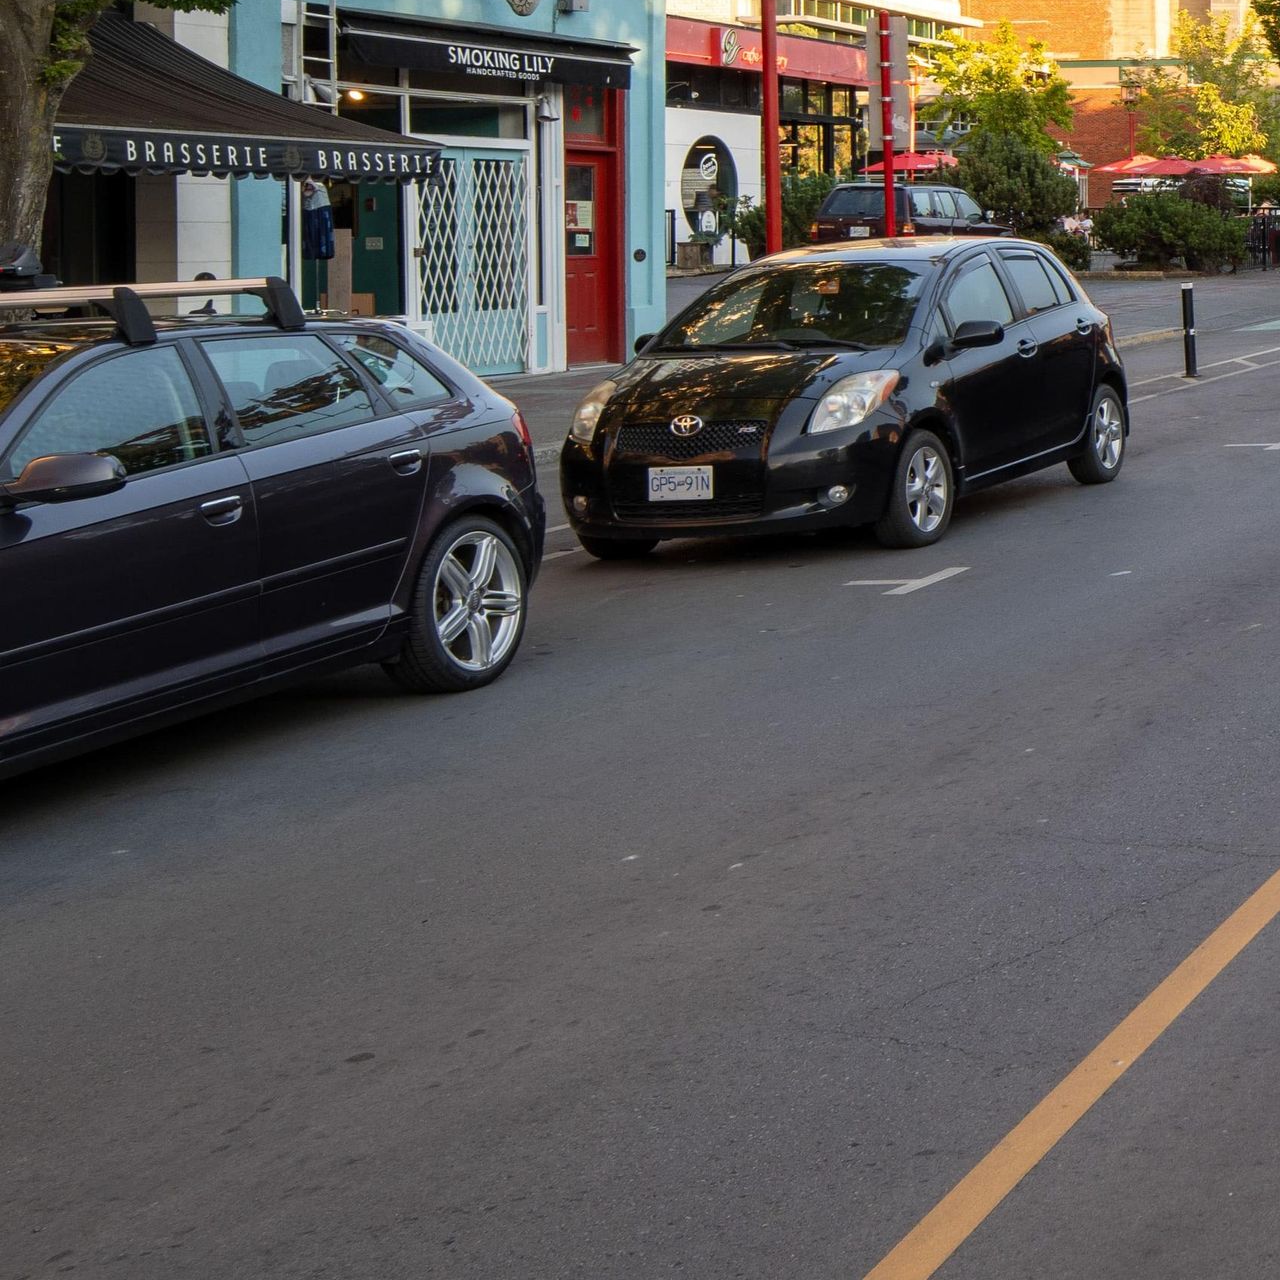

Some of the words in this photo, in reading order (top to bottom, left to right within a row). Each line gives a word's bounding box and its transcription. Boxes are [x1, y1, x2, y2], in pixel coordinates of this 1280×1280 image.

[448, 46, 520, 70] SMOKING
[524, 55, 554, 73] LILY
[466, 67, 517, 79] HANDCRAFTED
[518, 72, 540, 81] GOODS
[126, 139, 268, 167] BRASSERIE
[318, 150, 433, 174] BRASSERIE
